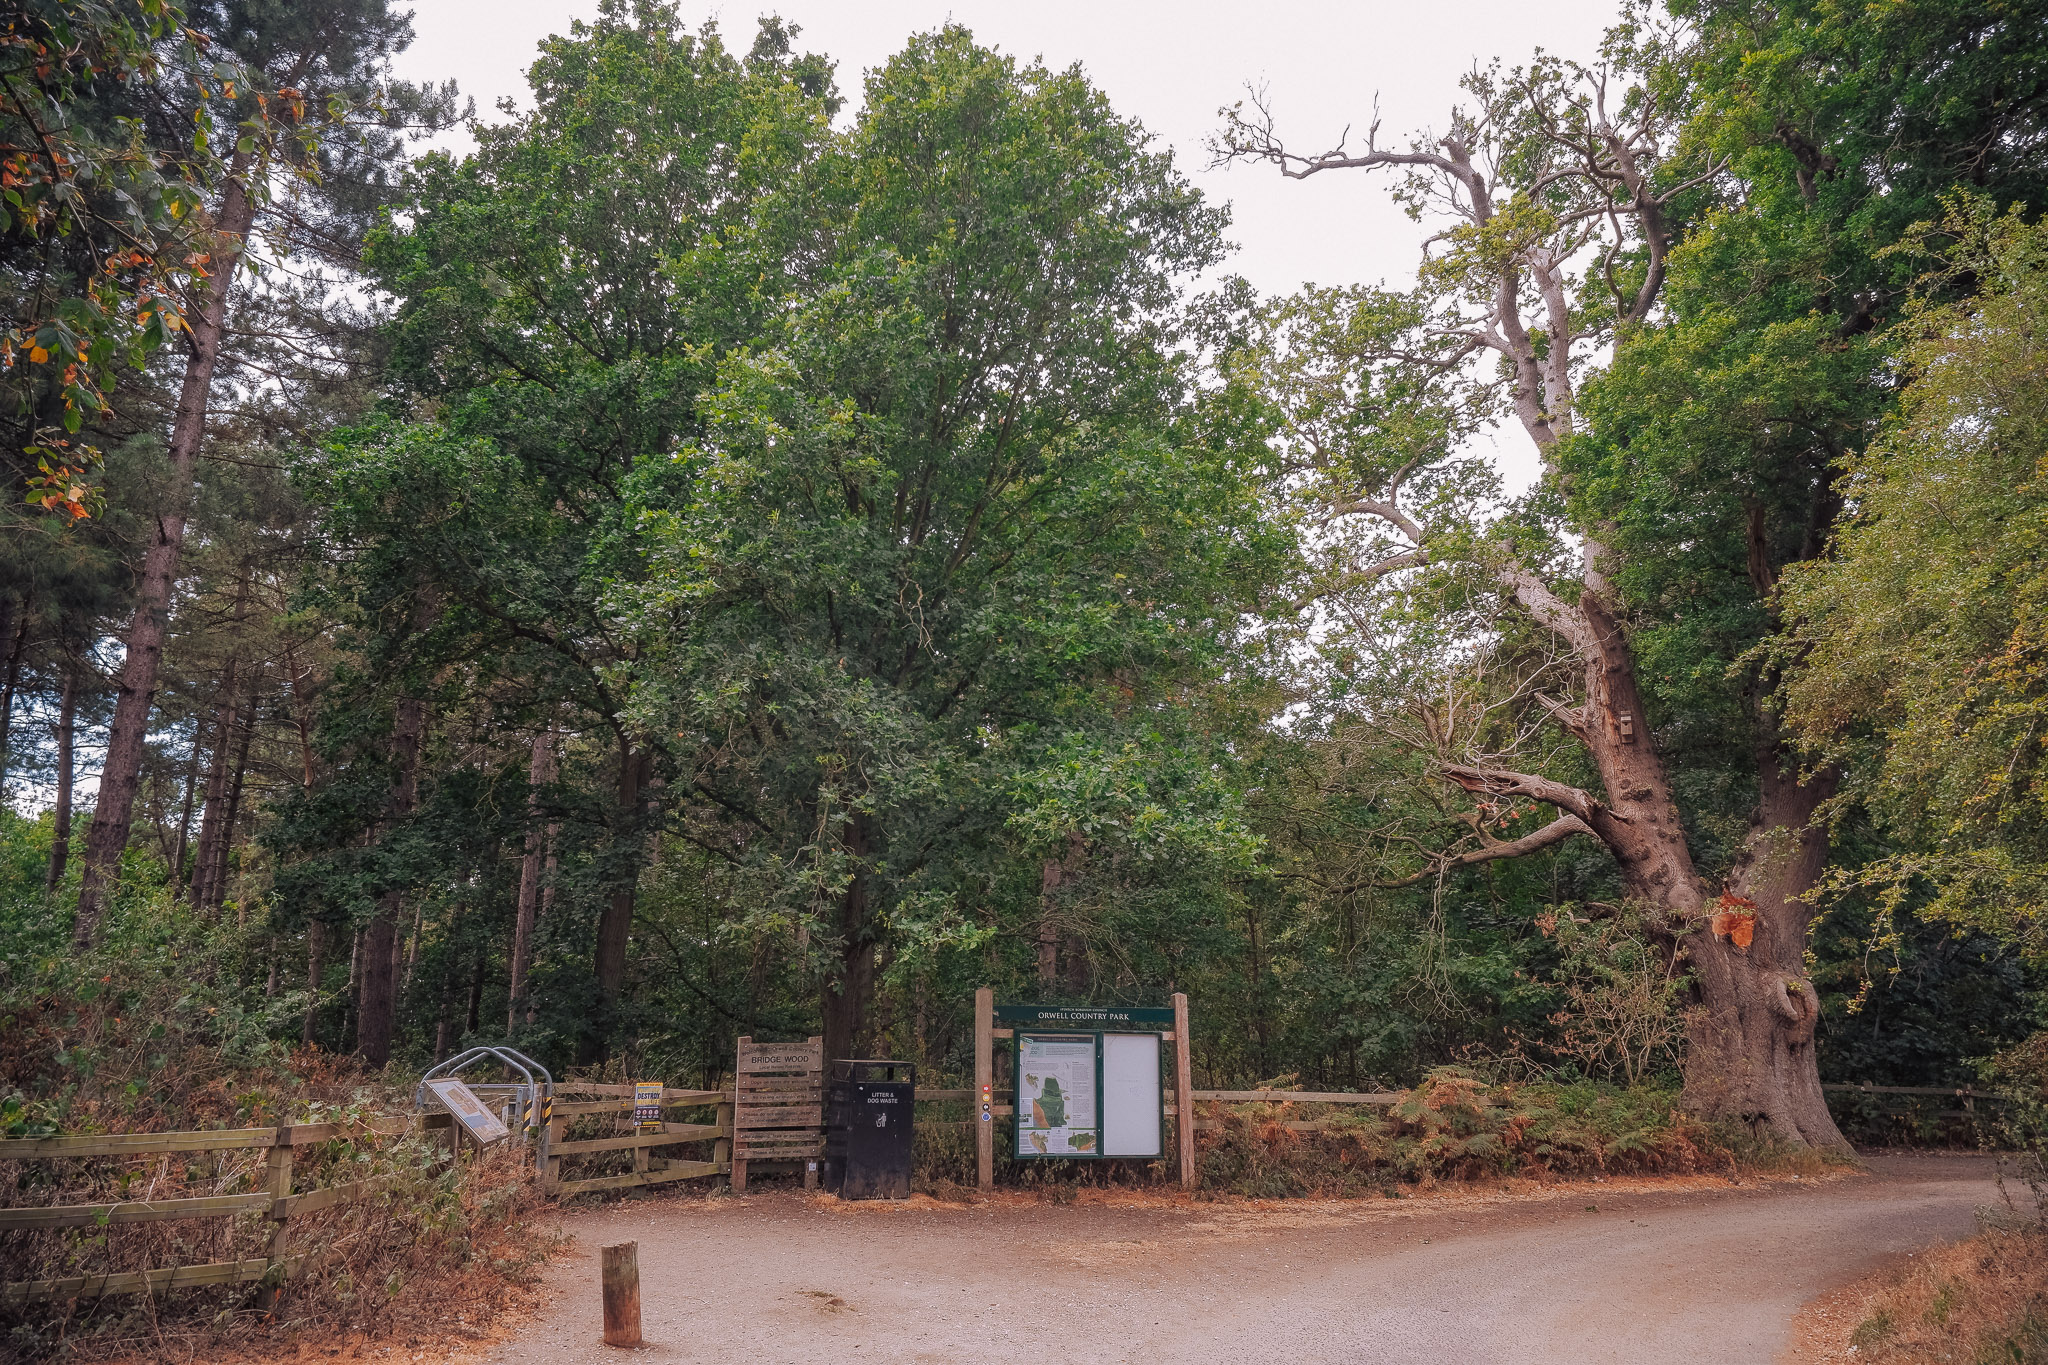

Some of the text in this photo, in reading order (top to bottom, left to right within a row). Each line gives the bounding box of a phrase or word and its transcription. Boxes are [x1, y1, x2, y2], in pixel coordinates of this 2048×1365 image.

[1038, 1011, 1130, 1021] ORWELL COUNTRY PARK
[751, 1055, 809, 1064] BRIDGE WOOD
